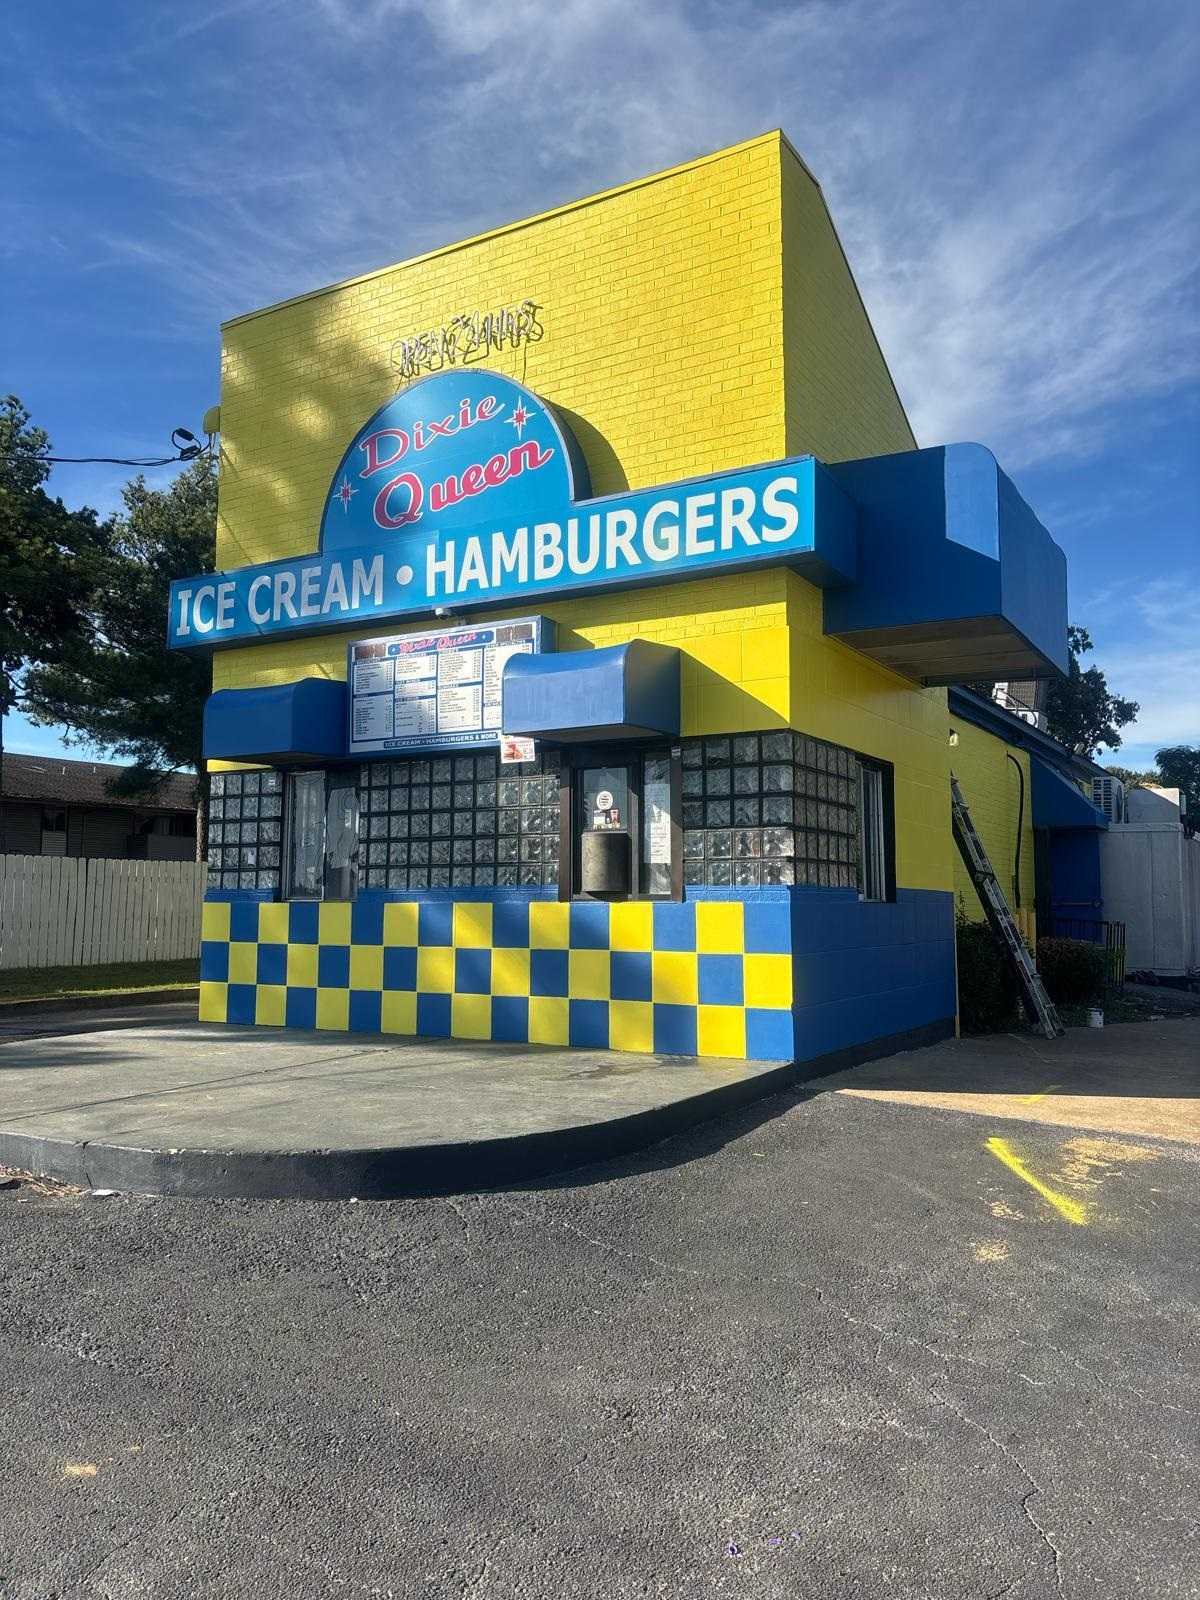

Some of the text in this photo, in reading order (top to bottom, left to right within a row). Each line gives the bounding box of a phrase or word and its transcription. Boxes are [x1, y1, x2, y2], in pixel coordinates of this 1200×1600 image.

[360, 396, 505, 478] Dixie
[373, 440, 554, 530] Queen
[177, 476, 799, 636] ICE CREAM HAMBURGERS
